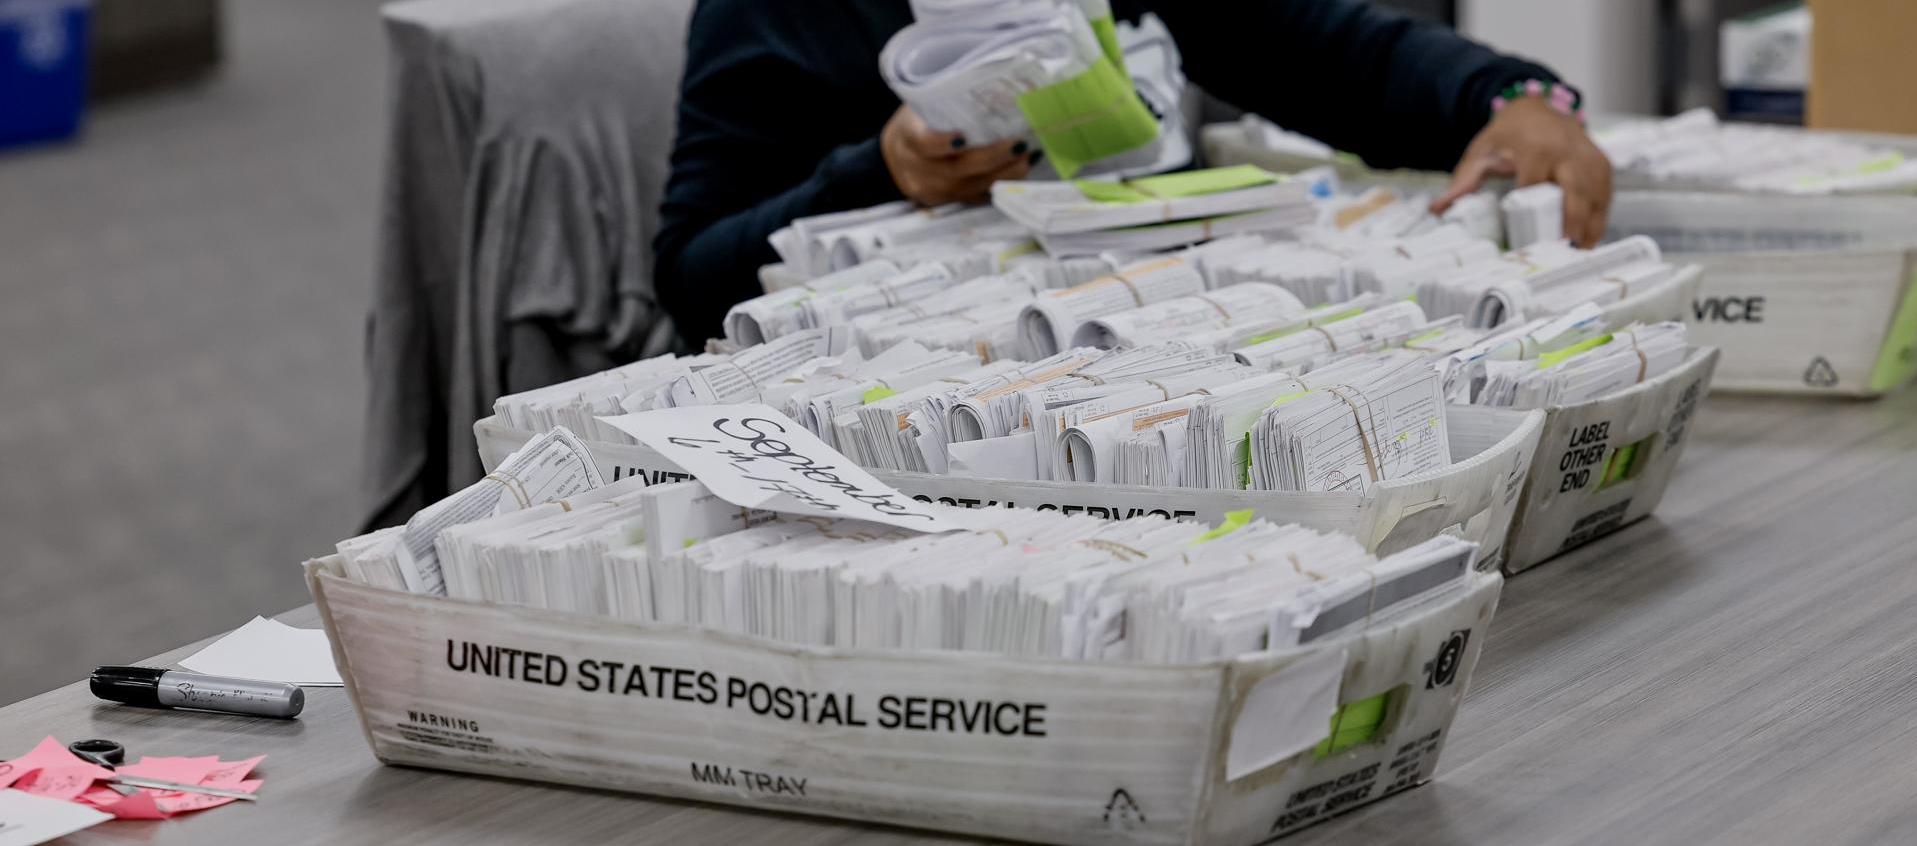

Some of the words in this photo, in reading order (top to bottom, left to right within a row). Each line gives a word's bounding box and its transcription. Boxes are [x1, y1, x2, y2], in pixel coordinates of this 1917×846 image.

[1692, 296, 1766, 324] VICE
[1569, 421, 1611, 448] LABEL
[712, 417, 935, 522] September
[1559, 444, 1606, 472] OTHER
[1559, 469, 1591, 493] END
[446, 640, 569, 687] UNITED
[577, 659, 718, 705] STATES
[727, 676, 868, 727] POSTAL
[877, 695, 1047, 737] SERVICE
[407, 710, 480, 733] WARNING
[690, 762, 736, 786] MM
[739, 769, 808, 797] TRAY
